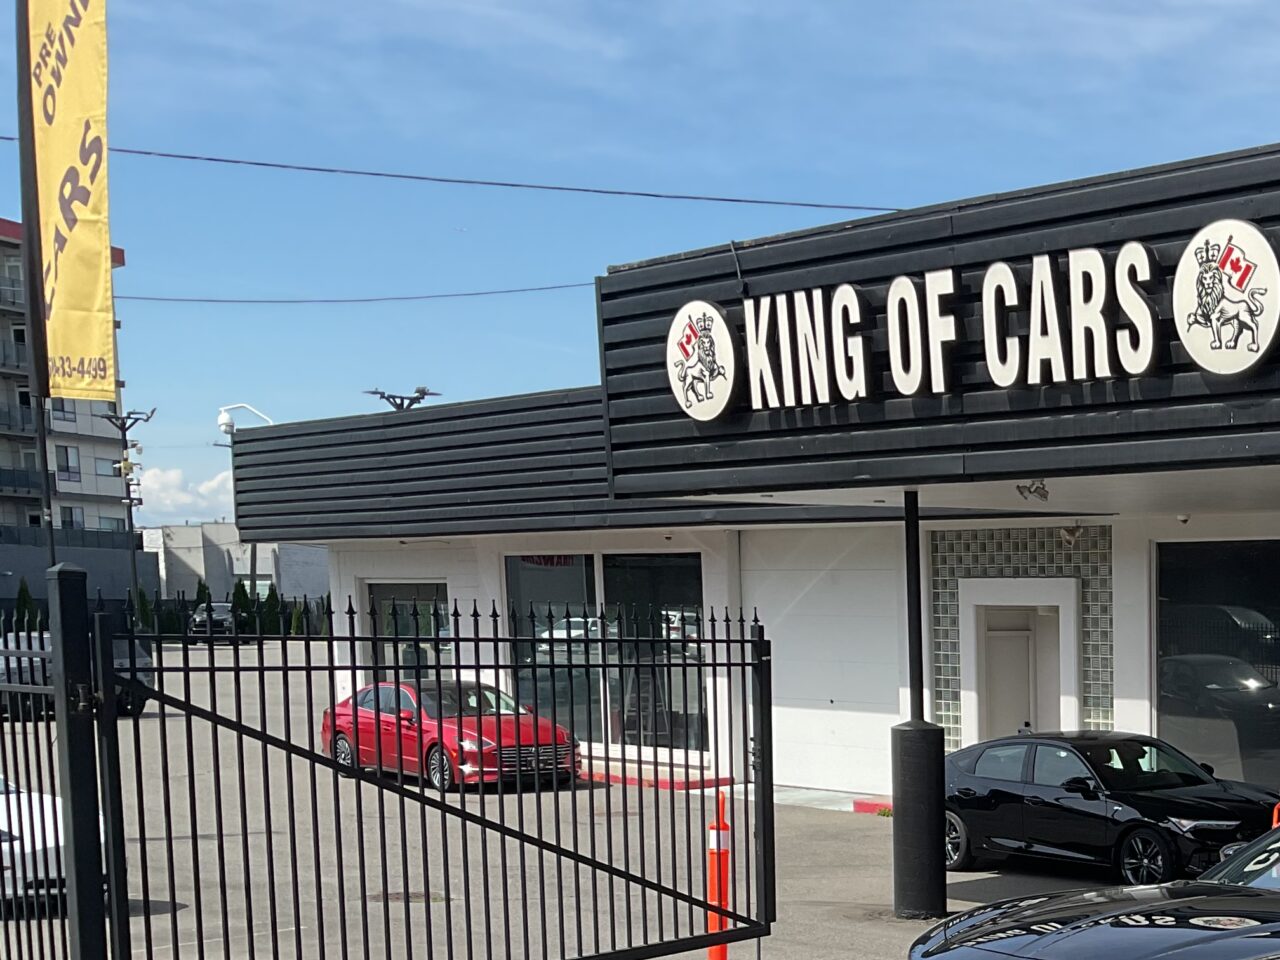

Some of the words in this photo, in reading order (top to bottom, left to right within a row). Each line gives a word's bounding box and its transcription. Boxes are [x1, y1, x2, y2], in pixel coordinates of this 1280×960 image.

[33, 21, 56, 88] PRE
[43, 0, 89, 126] OWN
[744, 283, 866, 410] KING
[887, 268, 956, 396] OF
[982, 241, 1156, 388] CARS
